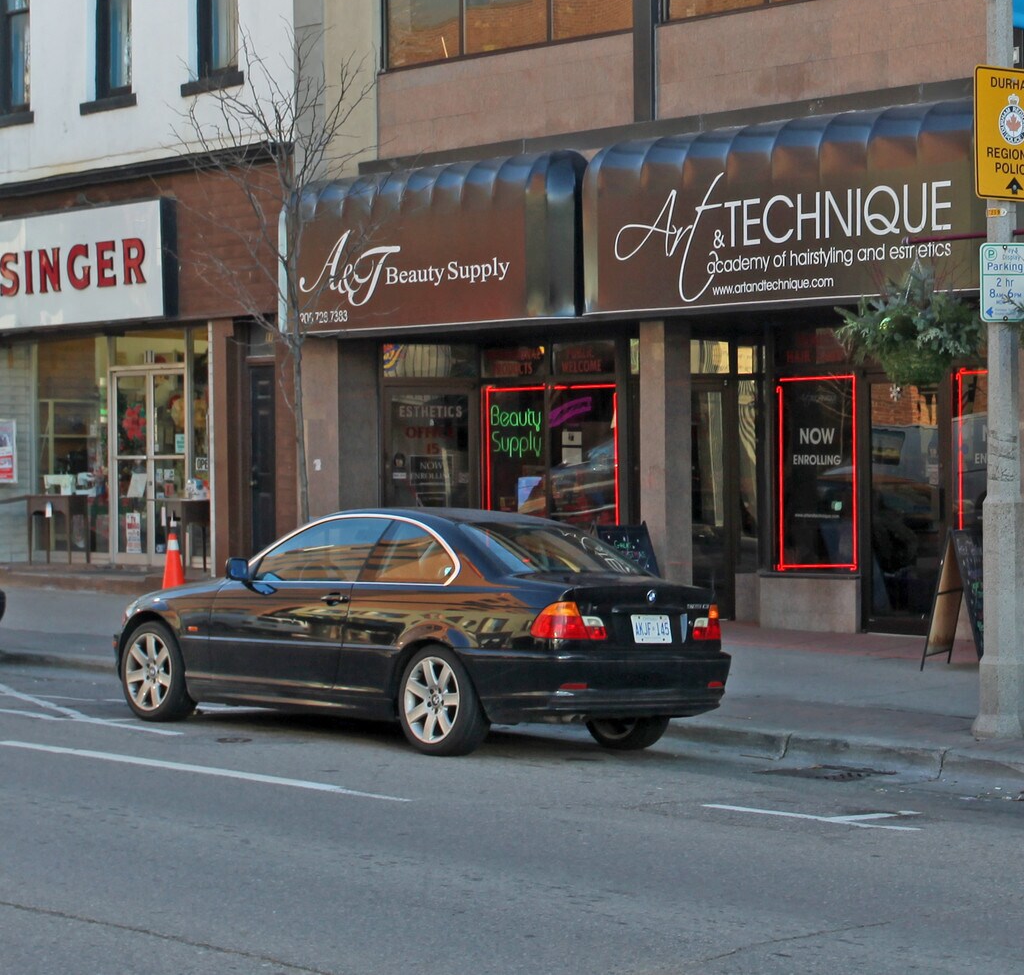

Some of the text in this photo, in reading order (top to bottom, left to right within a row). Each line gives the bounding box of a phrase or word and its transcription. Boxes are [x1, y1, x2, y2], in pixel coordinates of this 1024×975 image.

[614, 172, 952, 302] Art & TECHNIQUE
[707, 254, 770, 275] academy
[773, 251, 787, 268] of
[790, 246, 853, 268] hairstyling
[857, 243, 886, 262] and
[0, 237, 147, 297] SINGER
[385, 265, 445, 286] Beauty
[447, 257, 510, 281] Supply
[987, 262, 1023, 273] Parking
[712, 276, 834, 296] www.artandtechnique.com
[996, 277, 1014, 287] 2 hr
[561, 359, 602, 373] WELCOME
[399, 405, 463, 419] ESTHETICS
[490, 404, 542, 432] Beauty
[799, 428, 835, 445] NOW
[491, 431, 542, 458] Supply
[197, 458, 208, 469] OPE
[420, 461, 443, 470] NOW
[793, 454, 842, 466] ENROLLING
[411, 472, 453, 480] ENROLLI
[656, 622, 670, 636] 145
